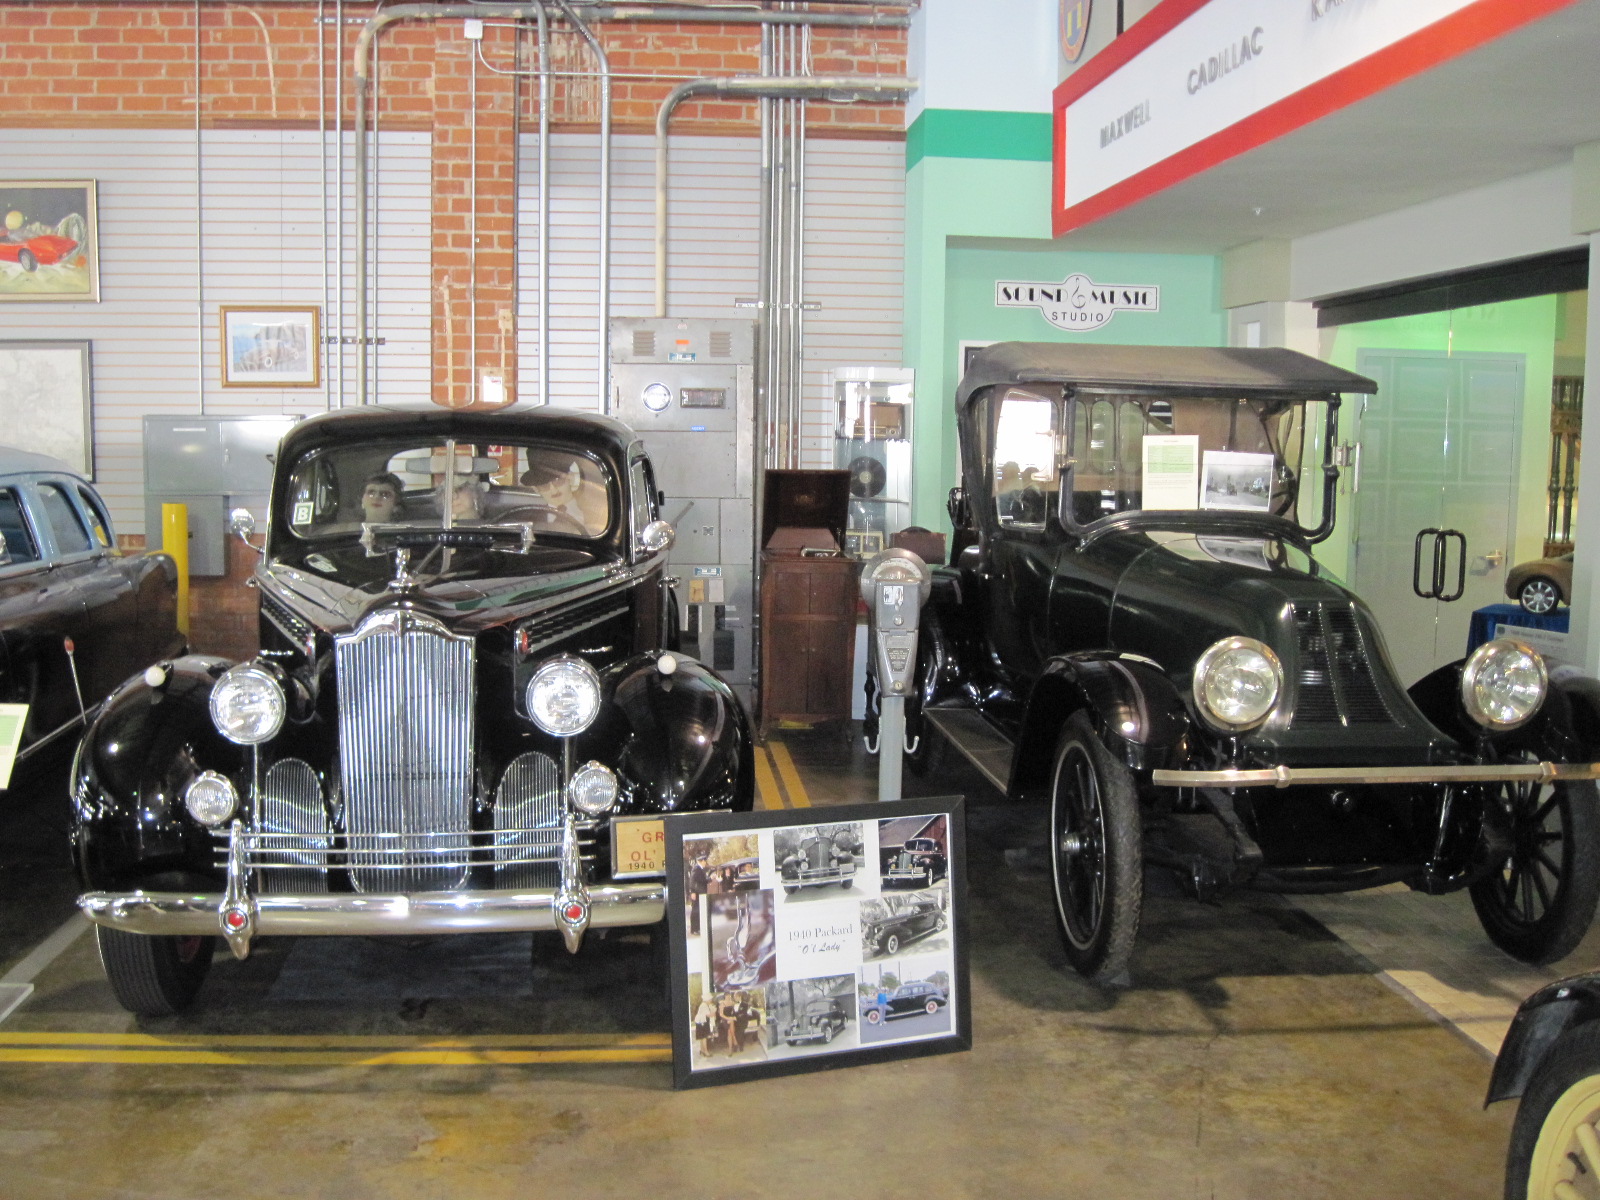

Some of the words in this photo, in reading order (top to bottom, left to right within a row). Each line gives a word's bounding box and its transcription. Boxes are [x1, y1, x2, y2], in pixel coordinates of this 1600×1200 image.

[1187, 26, 1264, 95] CADILLAC
[1100, 99, 1151, 149] MAXWELL
[1002, 286, 1068, 302] SOUND
[1091, 290, 1153, 305] MUSIC
[1051, 311, 1104, 322] STUDIO
[629, 861, 655, 870] 1940
[789, 929, 812, 941] 1940
[815, 923, 853, 938] Packard
